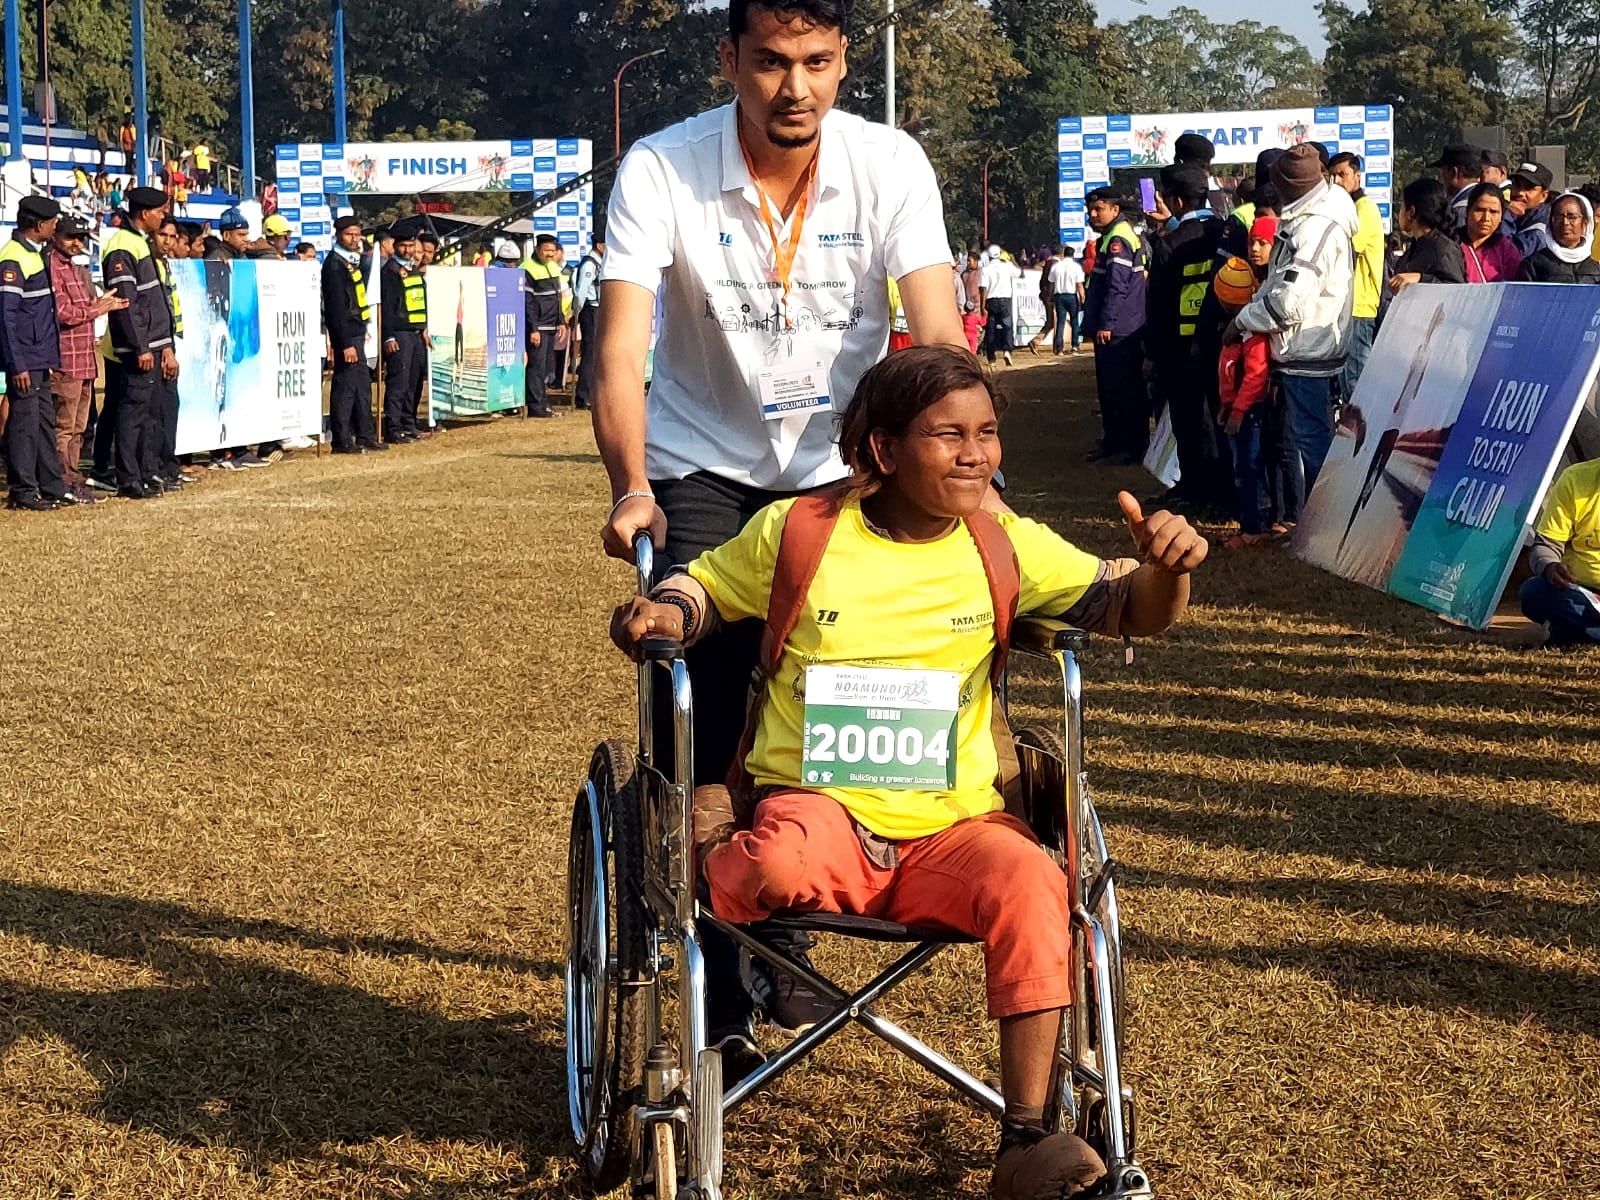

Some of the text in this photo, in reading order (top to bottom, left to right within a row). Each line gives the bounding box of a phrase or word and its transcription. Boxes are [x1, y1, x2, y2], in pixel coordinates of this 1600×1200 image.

[1183, 127, 1263, 146] TART
[388, 158, 466, 176] FINISH
[797, 280, 847, 290] TOMORROW
[276, 311, 305, 338] I RUN
[500, 313, 516, 336] RUN
[277, 341, 305, 366] TO BE
[277, 368, 306, 399] FREE
[776, 398, 819, 411] VOLUNTEER
[1481, 378, 1550, 434] I RUN
[1466, 436, 1524, 475] TO STAY
[1446, 476, 1506, 531] CALM
[950, 611, 993, 626] TATA STEEL
[834, 681, 901, 694] NOAMUNDI
[810, 723, 949, 766] 20004
[850, 774, 878, 784] Building
[886, 776, 914, 784] greener
